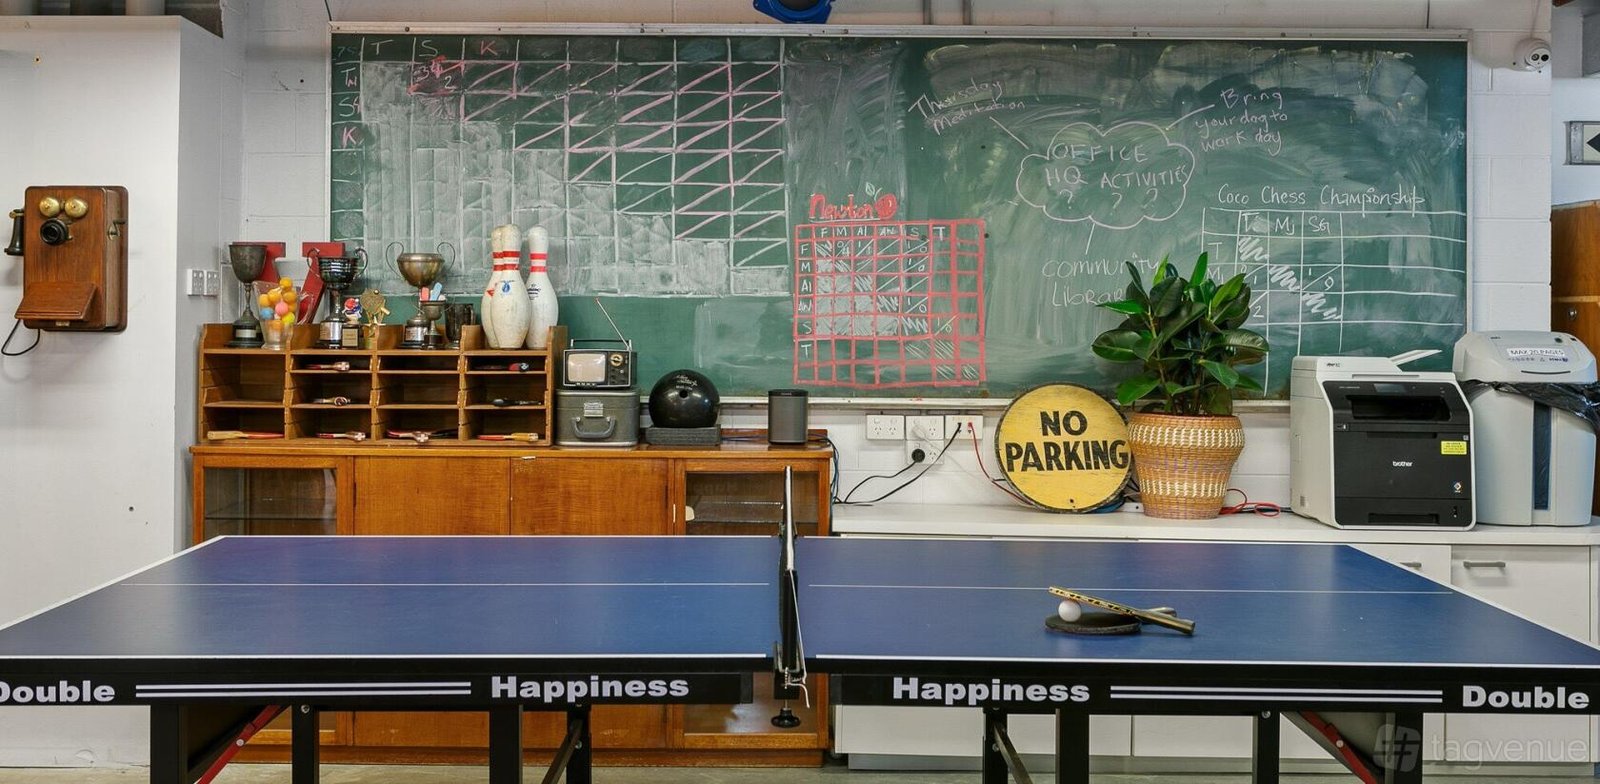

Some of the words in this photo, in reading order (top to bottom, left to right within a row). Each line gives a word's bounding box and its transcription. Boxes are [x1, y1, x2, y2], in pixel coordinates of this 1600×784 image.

[371, 40, 394, 55] T
[419, 40, 438, 57] S
[480, 40, 498, 56] K
[1220, 88, 1283, 109] Bring
[1196, 116, 1236, 139] your
[1240, 108, 1269, 133] dog
[1270, 110, 1288, 121] to
[342, 126, 358, 149] K
[1255, 128, 1281, 156] day
[1052, 143, 1149, 163] OFFICE
[1045, 165, 1088, 187] HQ
[1101, 164, 1189, 189] ACTIVITIES
[1218, 184, 1249, 205] Coco
[1261, 185, 1306, 205] Chess
[1320, 184, 1426, 218] Championship
[836, 226, 847, 237] M
[933, 226, 946, 241] T
[801, 243, 809, 255] F
[1208, 242, 1222, 260] T
[801, 262, 811, 273] M
[801, 344, 811, 358] T
[1040, 410, 1088, 436] NO
[1005, 440, 1129, 473] PARKING
[491, 675, 690, 703] Happiness
[893, 677, 1090, 706] Happiness
[1462, 685, 1590, 709] Double
